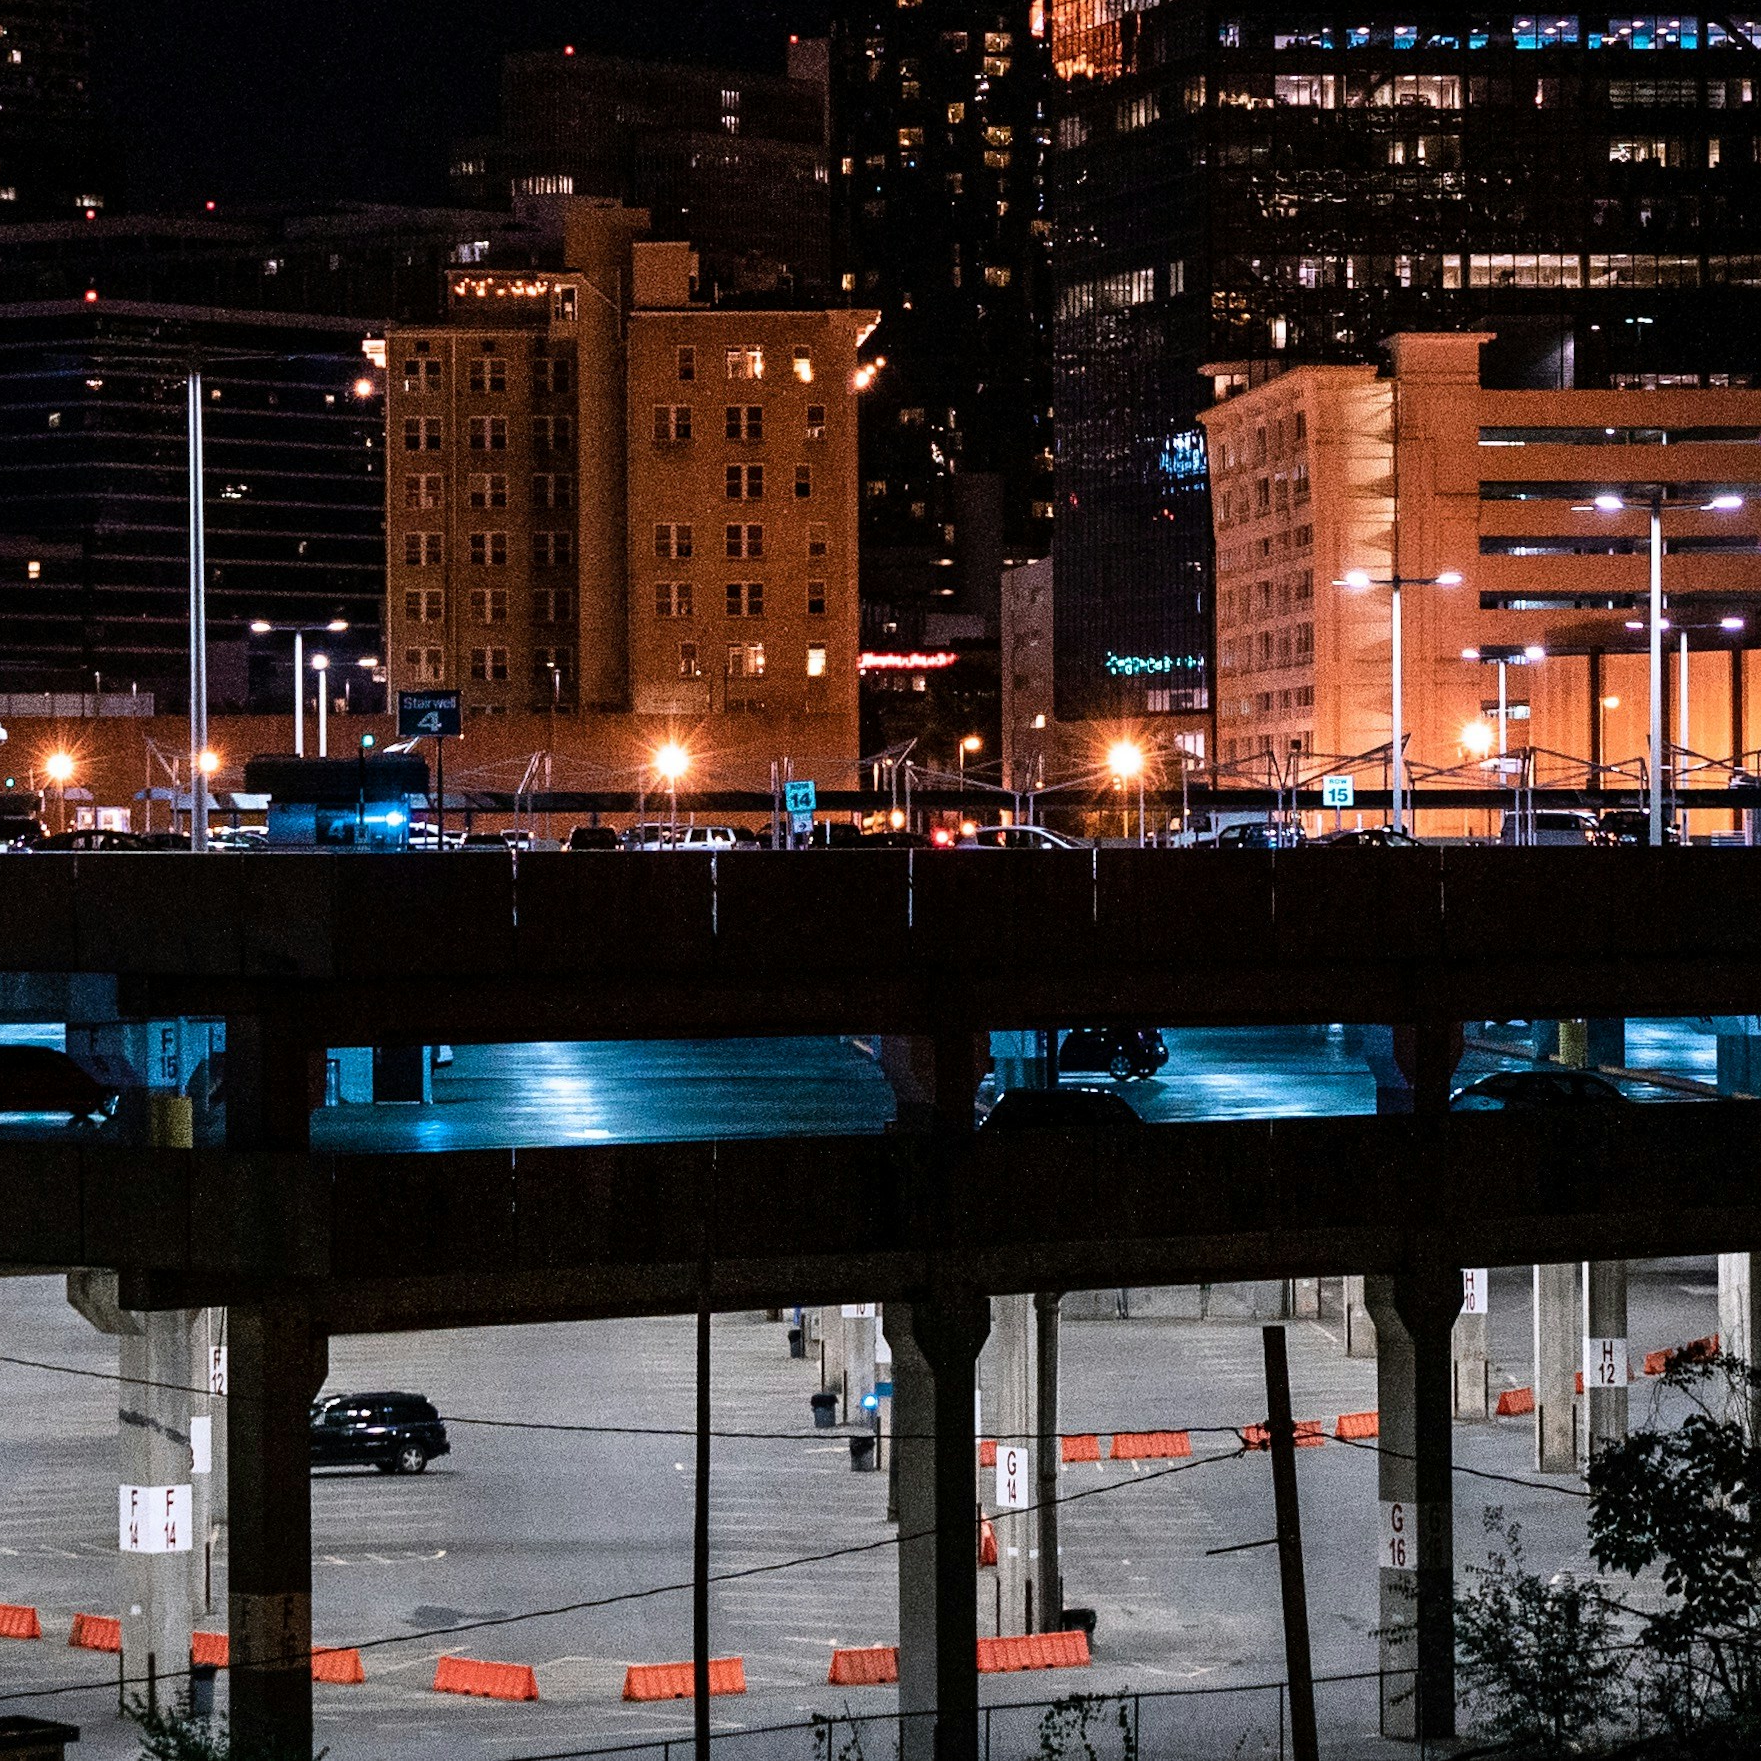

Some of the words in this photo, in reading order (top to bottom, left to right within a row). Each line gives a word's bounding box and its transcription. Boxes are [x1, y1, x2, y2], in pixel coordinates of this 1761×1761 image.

[403, 696, 457, 710] Stairwell
[417, 710, 442, 732] 4
[790, 792, 811, 808] 14
[1328, 788, 1348, 802] 15
[162, 1028, 174, 1053] F
[1465, 1271, 1475, 1290] H
[1602, 1340, 1613, 1362] H
[212, 1373, 224, 1396] 12
[1599, 1363, 1615, 1384] 12
[1007, 1450, 1017, 1475] G
[166, 1489, 175, 1517] F
[1007, 1478, 1017, 1503] 14
[131, 1490, 138, 1517] F
[1392, 1503, 1403, 1532] G
[130, 1521, 138, 1549] 14
[164, 1521, 176, 1549] 14
[1389, 1537, 1406, 1567] 16
